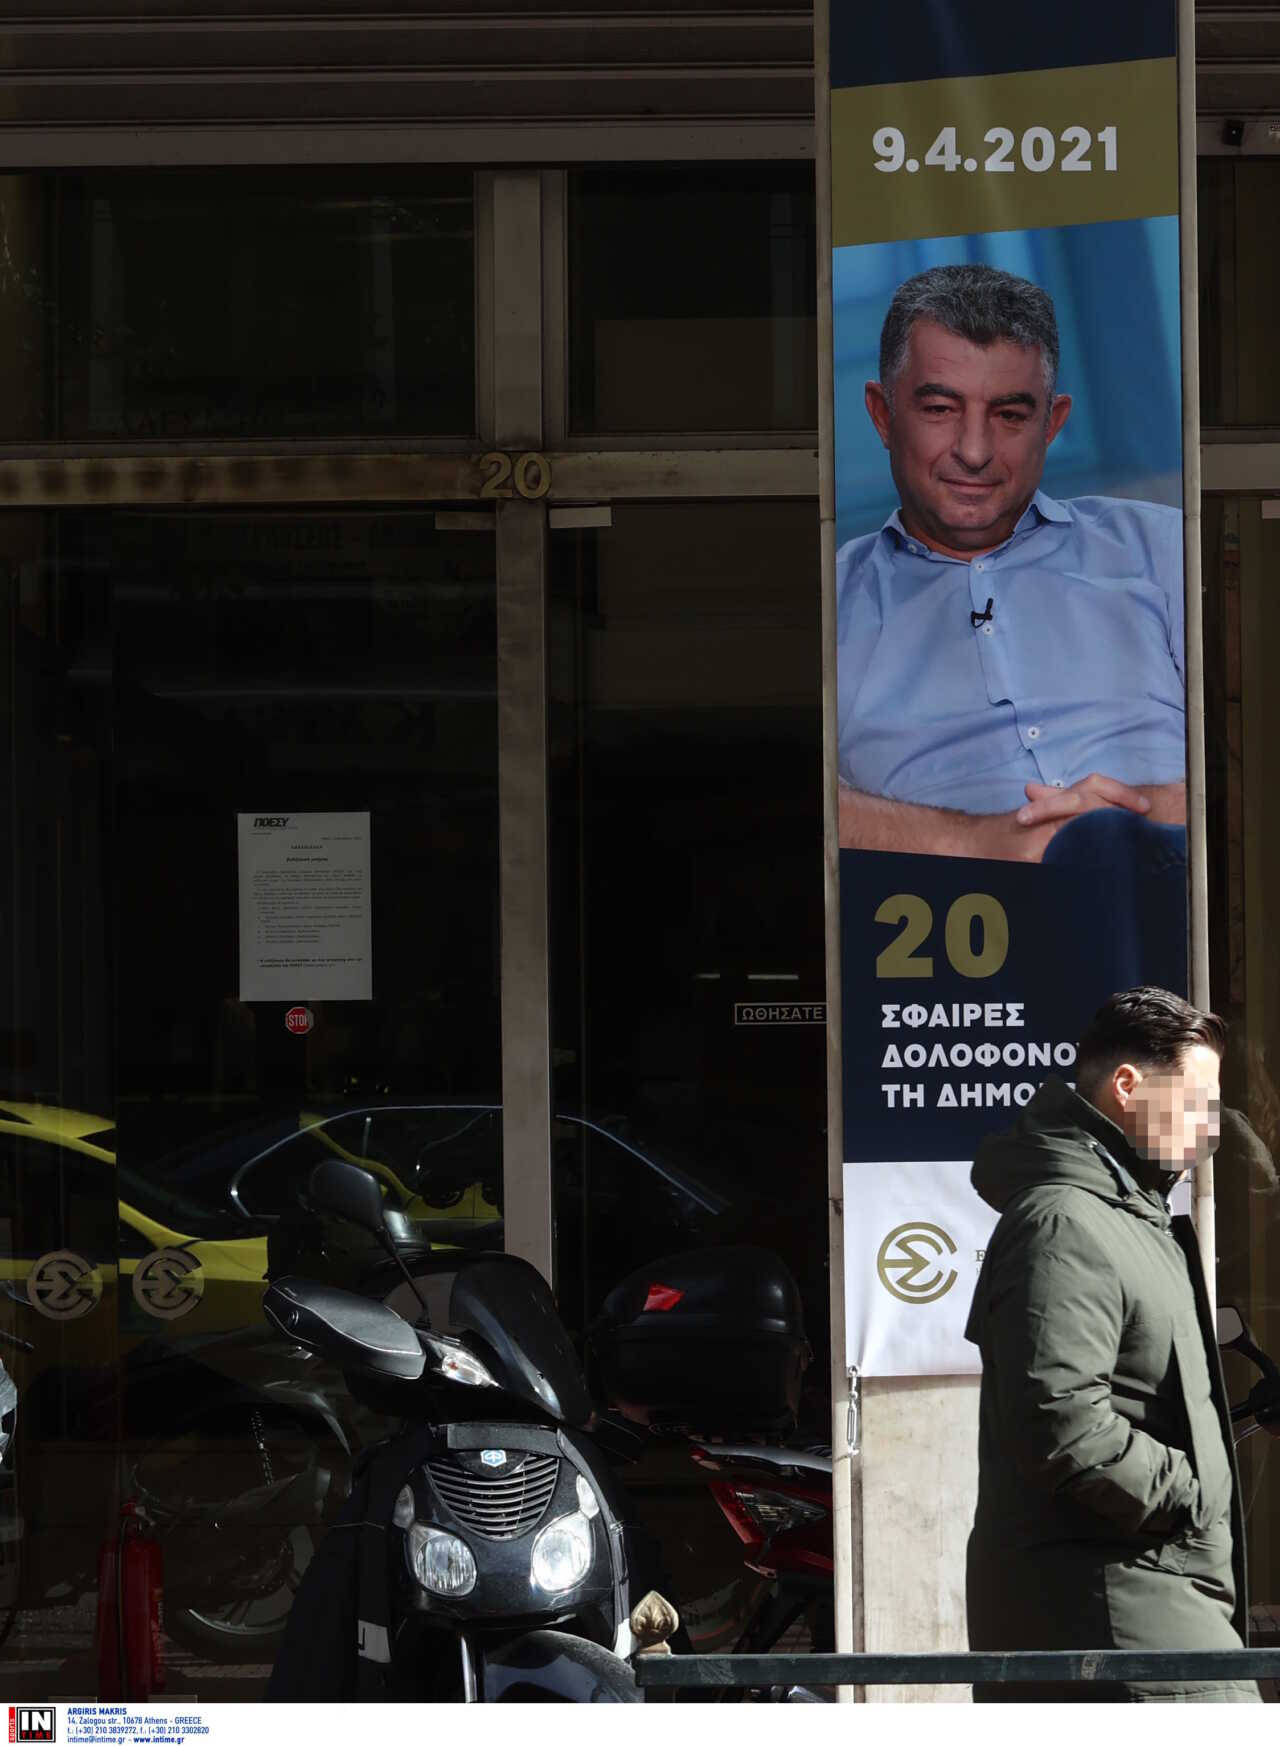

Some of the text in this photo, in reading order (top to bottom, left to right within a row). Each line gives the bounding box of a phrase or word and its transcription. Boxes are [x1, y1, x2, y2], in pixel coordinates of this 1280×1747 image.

[872, 126, 1118, 172] 9.4.2021
[480, 452, 553, 499] 20
[874, 892, 1010, 979] 20
[742, 1007, 825, 1021] ΩΘΗΣΑΤΕ
[880, 1003, 1025, 1028] ΣΦΑΙΡΕΣ
[880, 1041, 1080, 1068] ΔΟΛΟΦΟΝΟ
[880, 1082, 925, 1108] ΤΗ
